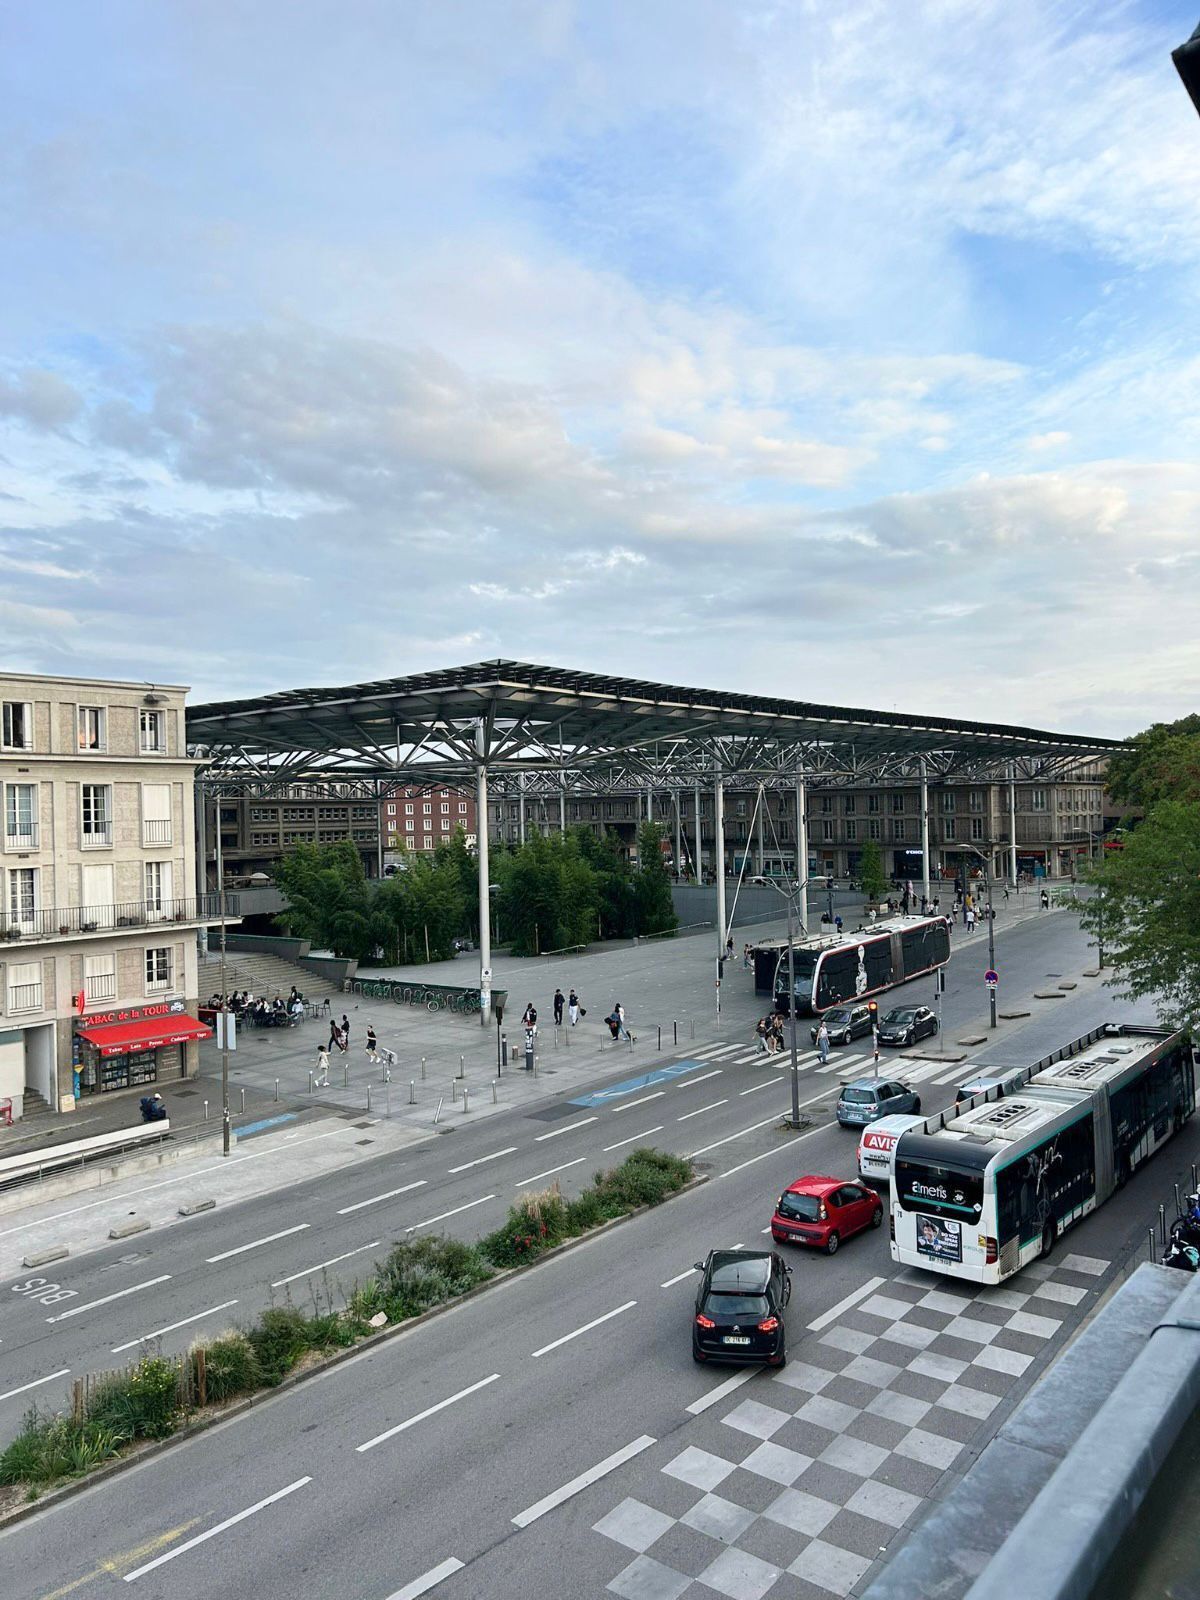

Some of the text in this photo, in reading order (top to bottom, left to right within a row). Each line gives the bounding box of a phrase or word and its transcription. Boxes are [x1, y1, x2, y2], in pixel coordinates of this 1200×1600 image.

[81, 1012, 115, 1026] TABAC
[118, 1012, 129, 1020] de
[131, 1009, 140, 1018] la
[142, 1004, 169, 1016] TOUR
[11, 1278, 79, 1306] BUS
